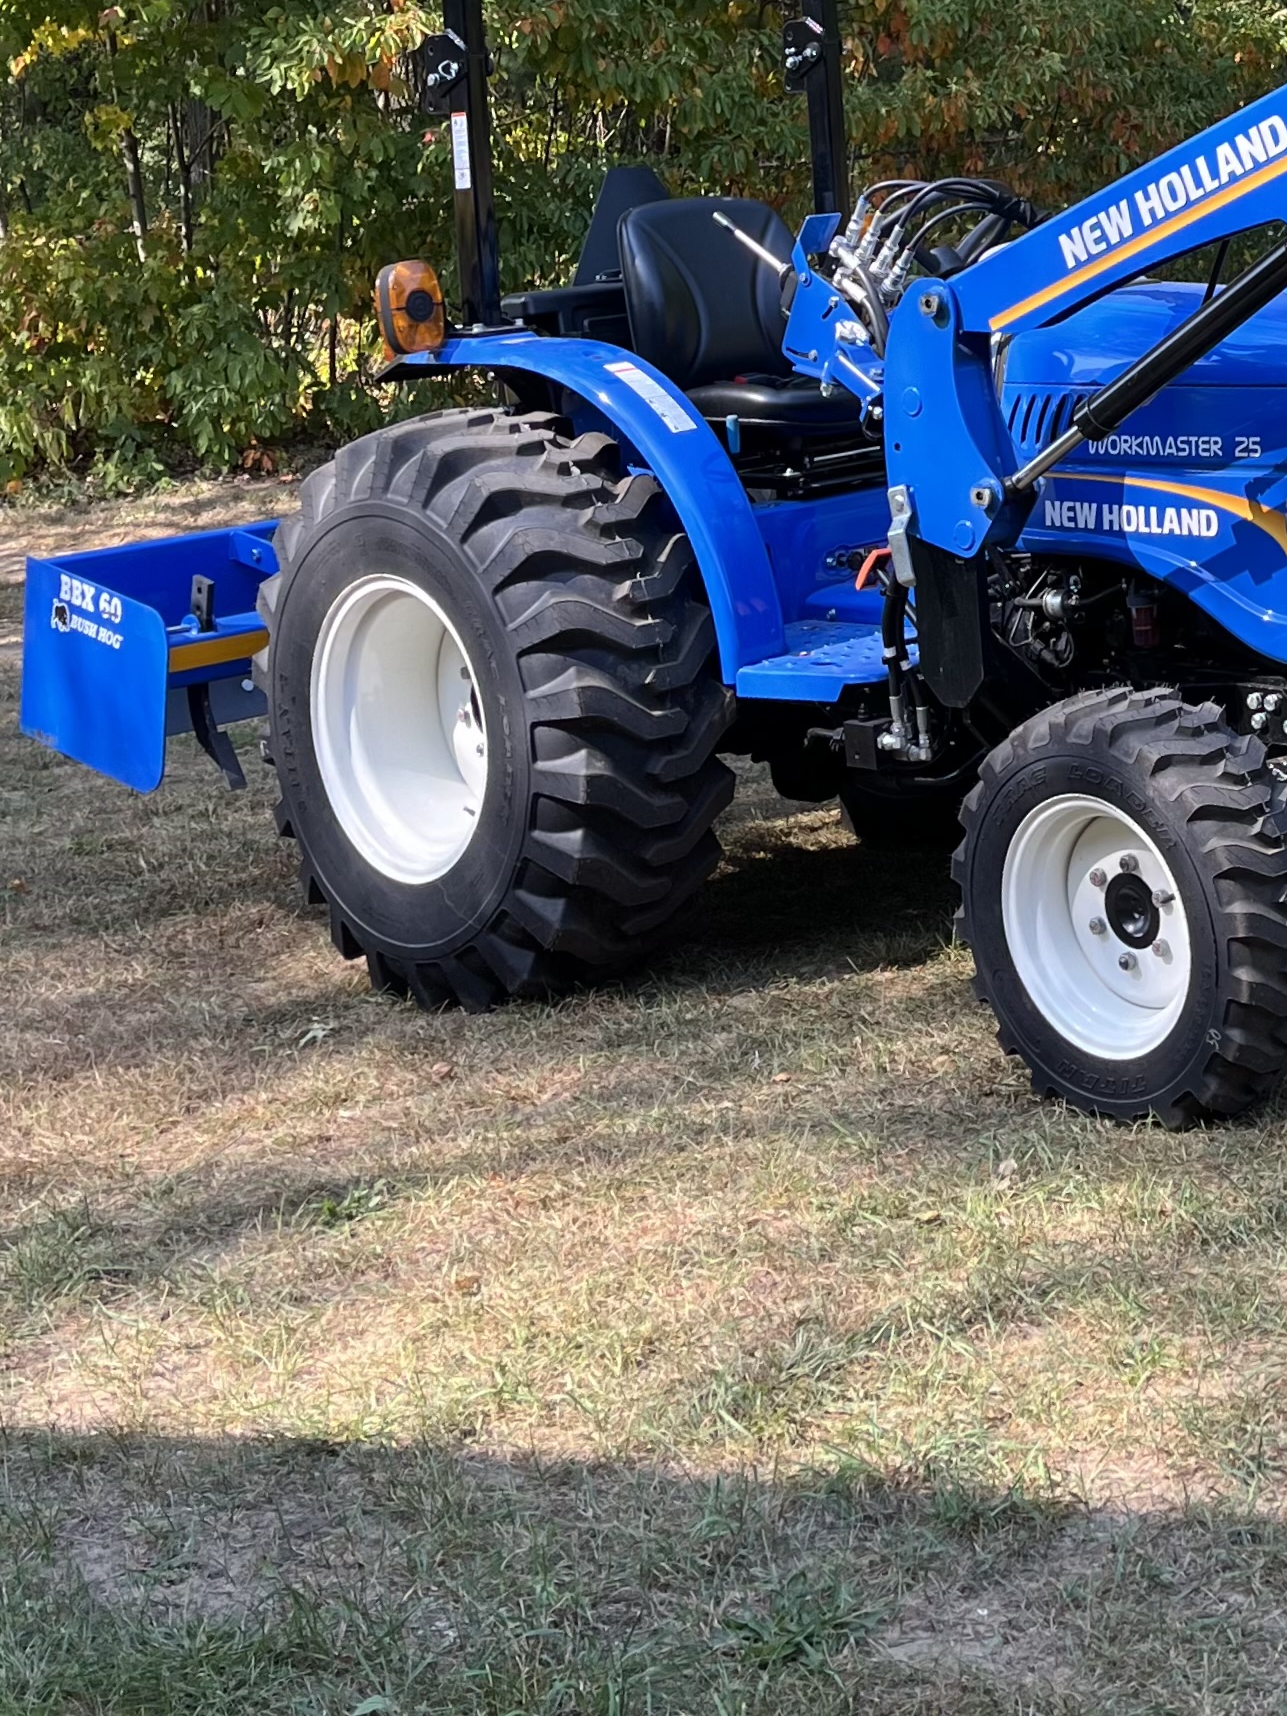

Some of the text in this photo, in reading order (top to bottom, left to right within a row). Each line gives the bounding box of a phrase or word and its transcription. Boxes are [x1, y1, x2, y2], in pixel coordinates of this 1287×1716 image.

[1058, 199, 1133, 269] NEW
[1088, 435, 1261, 458] WORKMASTER 25
[1045, 500, 1219, 537] NEW HOLLAND
[60, 573, 122, 624] BBX 60
[71, 614, 121, 650] BUSH HOG
[1066, 762, 1178, 850] LOADER
[1055, 1058, 1148, 1095] TITAN
